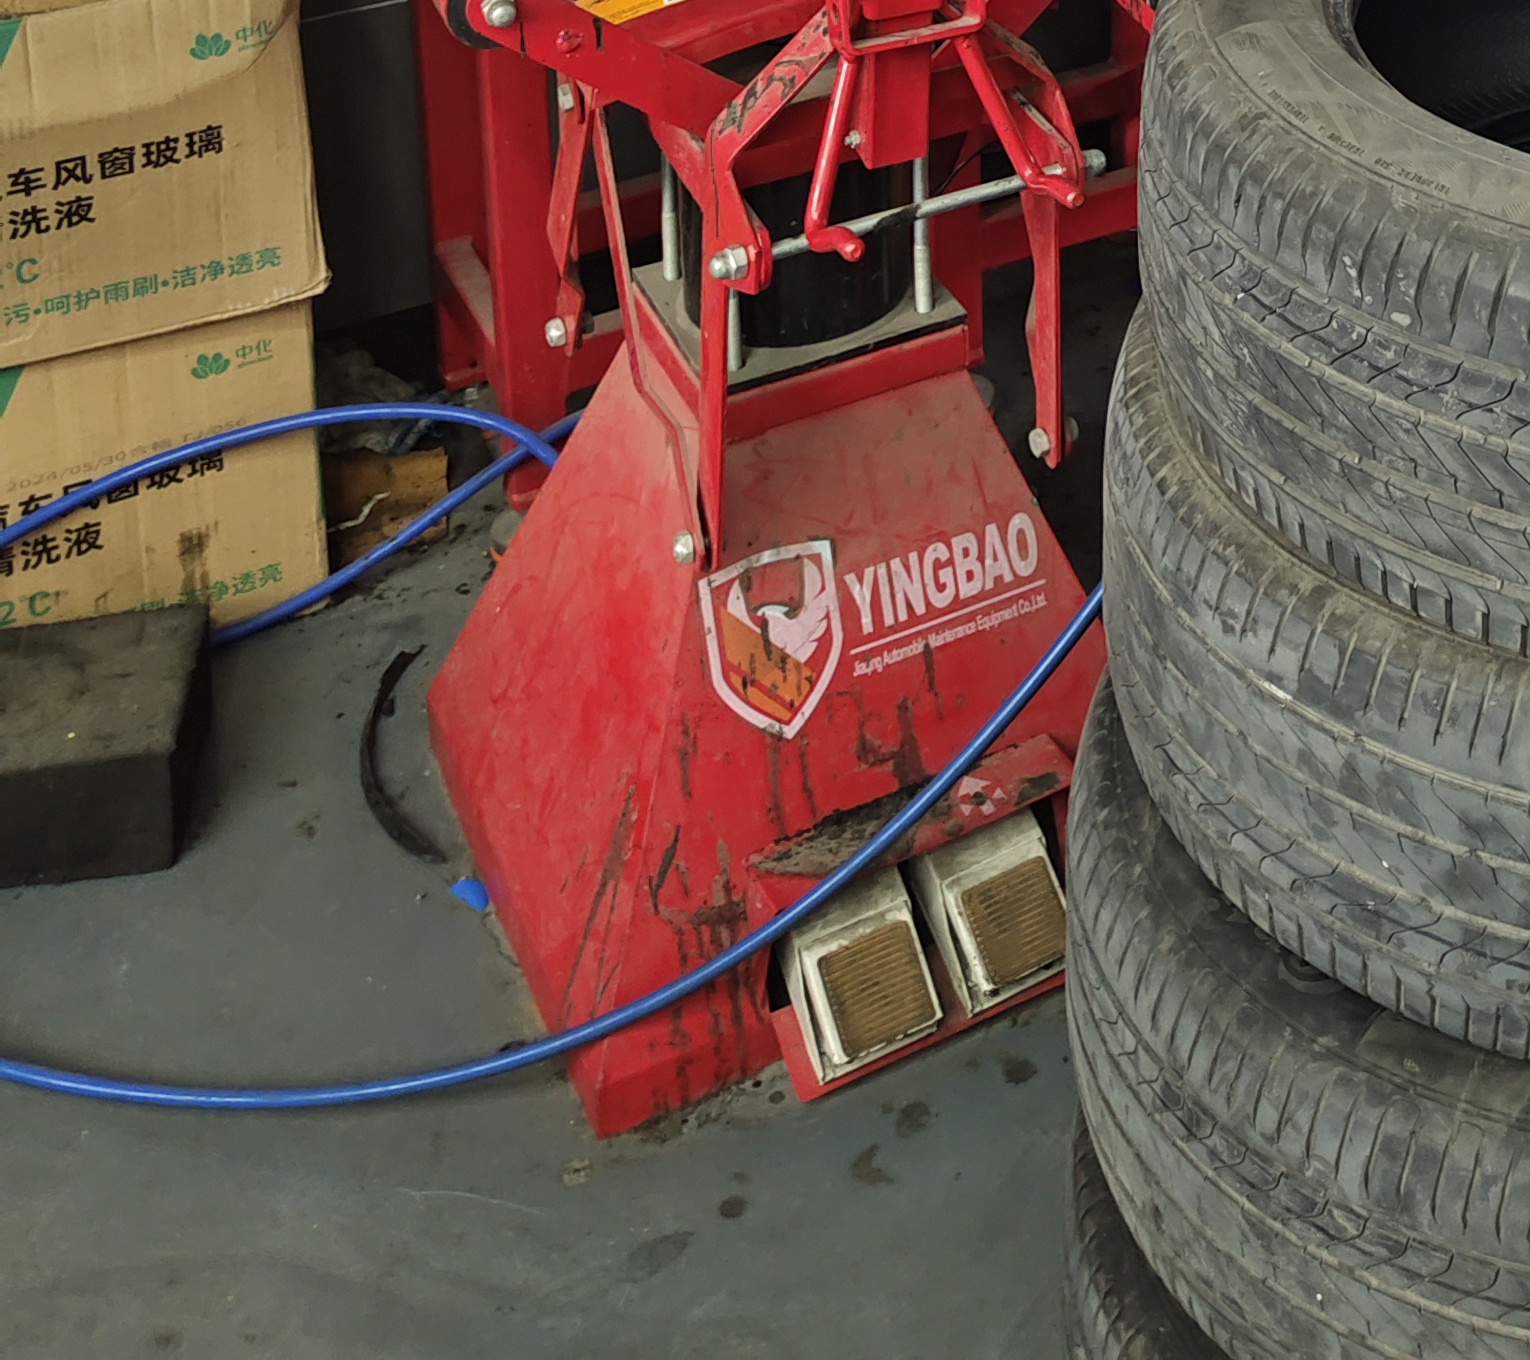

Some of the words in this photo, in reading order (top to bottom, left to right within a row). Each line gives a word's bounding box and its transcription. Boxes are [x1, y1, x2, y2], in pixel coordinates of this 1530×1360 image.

[0, 125, 224, 200] 车风窗玻璃
[0, 195, 97, 242] 洗液
[235, 338, 273, 361] 中化
[843, 511, 1040, 636] YINGBAO
